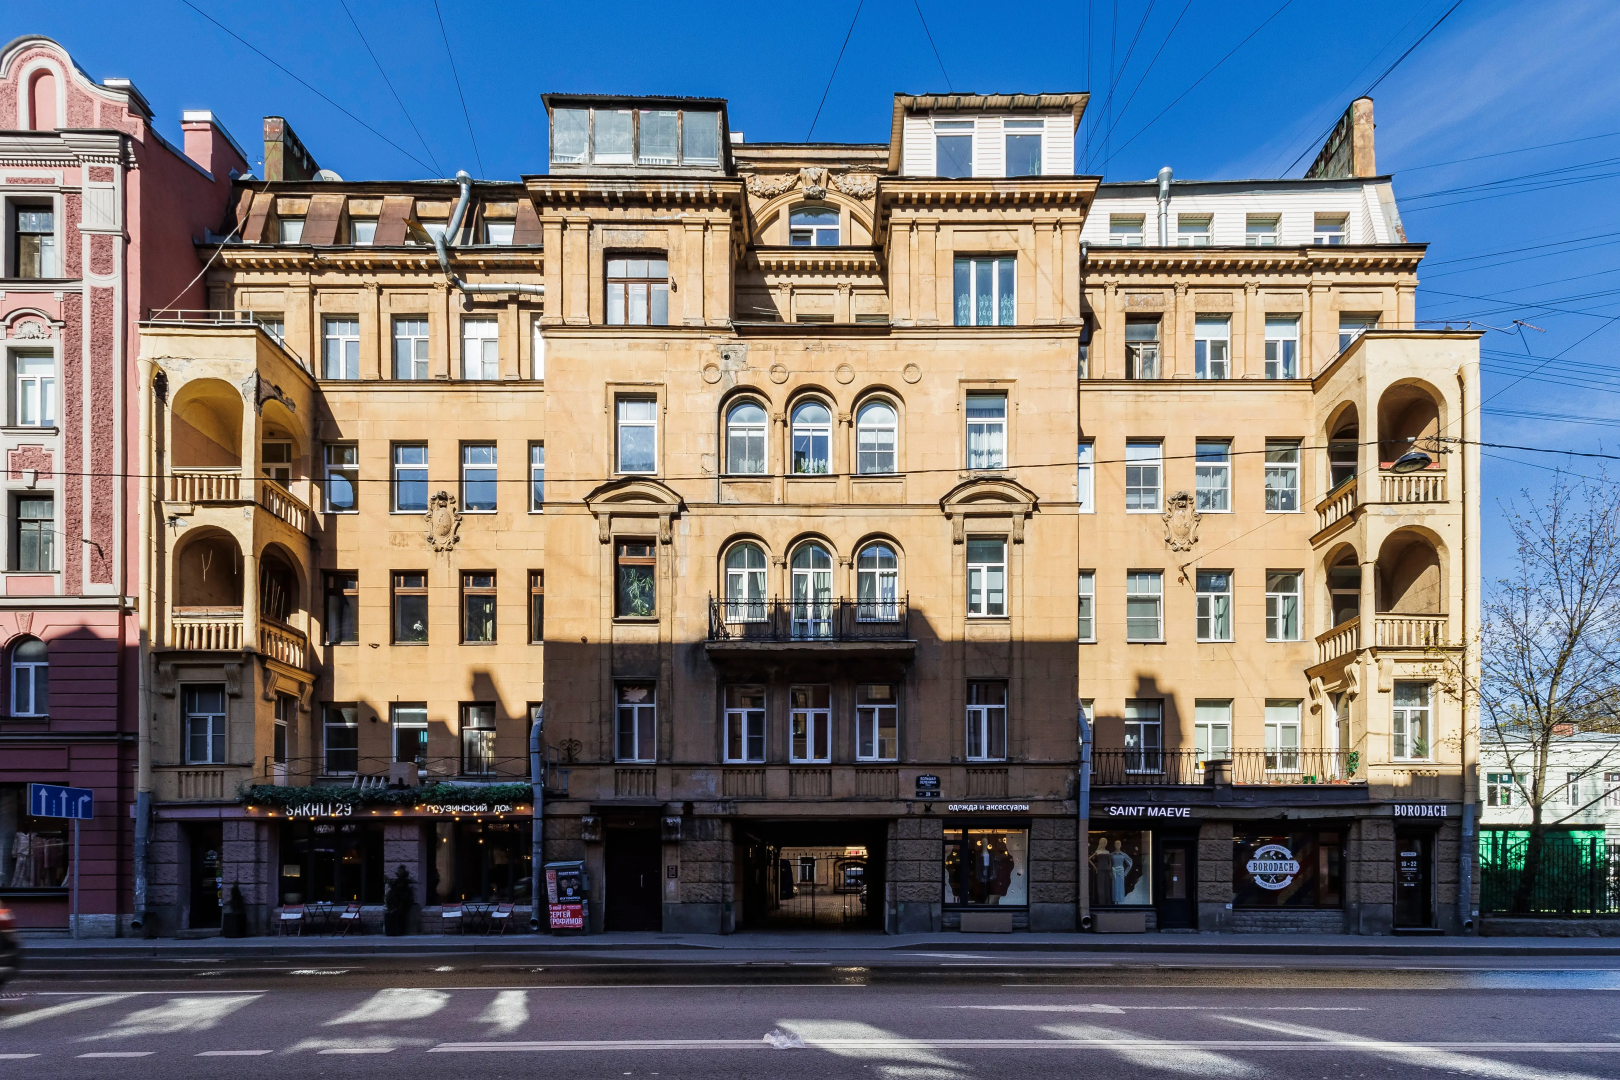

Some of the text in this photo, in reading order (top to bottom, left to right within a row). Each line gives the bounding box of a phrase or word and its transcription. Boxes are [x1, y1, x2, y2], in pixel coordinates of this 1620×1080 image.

[286, 803, 352, 816] SAKHLI 29
[427, 803, 488, 814] грузинский
[1109, 806, 1191, 818] SAINT MAEVE
[1394, 804, 1448, 816] BORODACH
[1252, 862, 1294, 872] BORODACH
